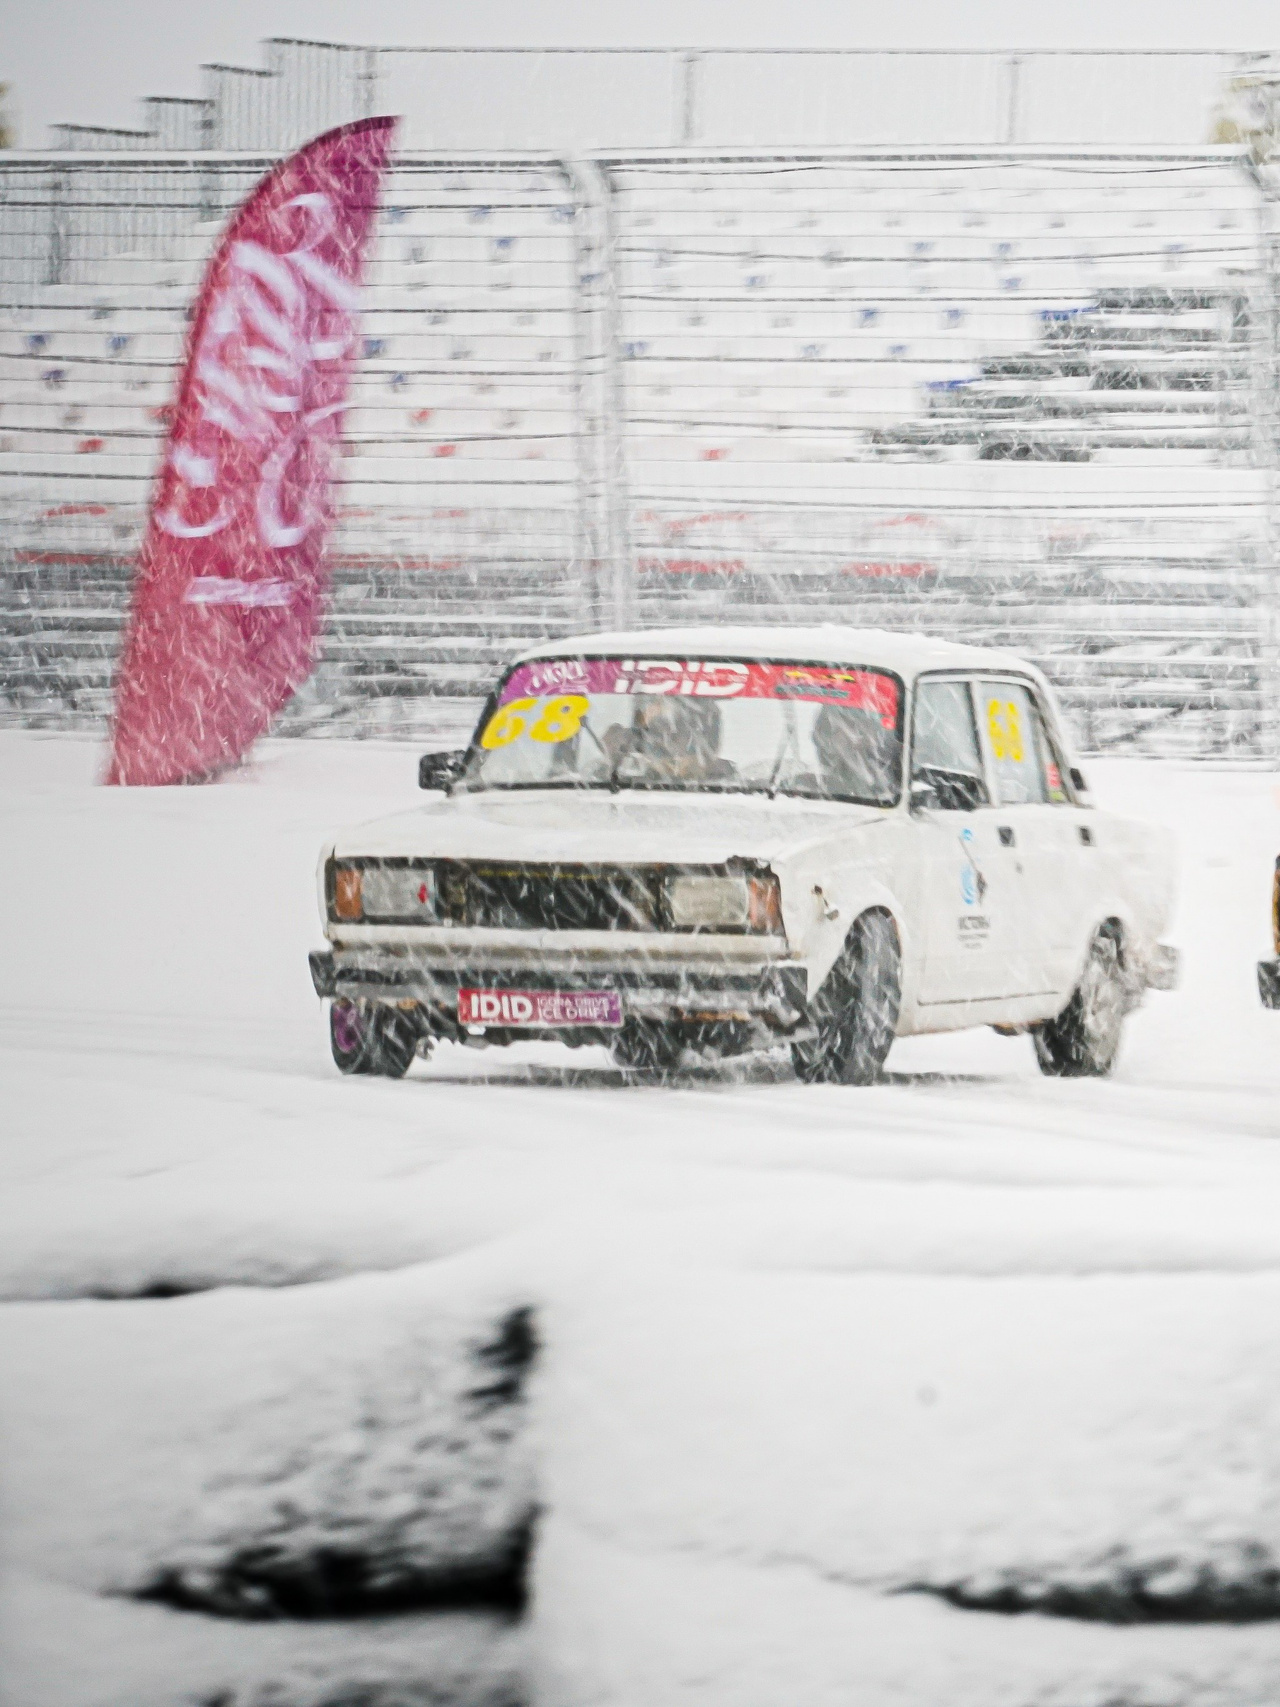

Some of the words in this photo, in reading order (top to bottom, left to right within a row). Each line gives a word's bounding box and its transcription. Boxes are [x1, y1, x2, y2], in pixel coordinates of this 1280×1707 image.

[614, 661, 750, 695] IDID
[481, 695, 590, 750] 68
[471, 993, 533, 1020] IDID
